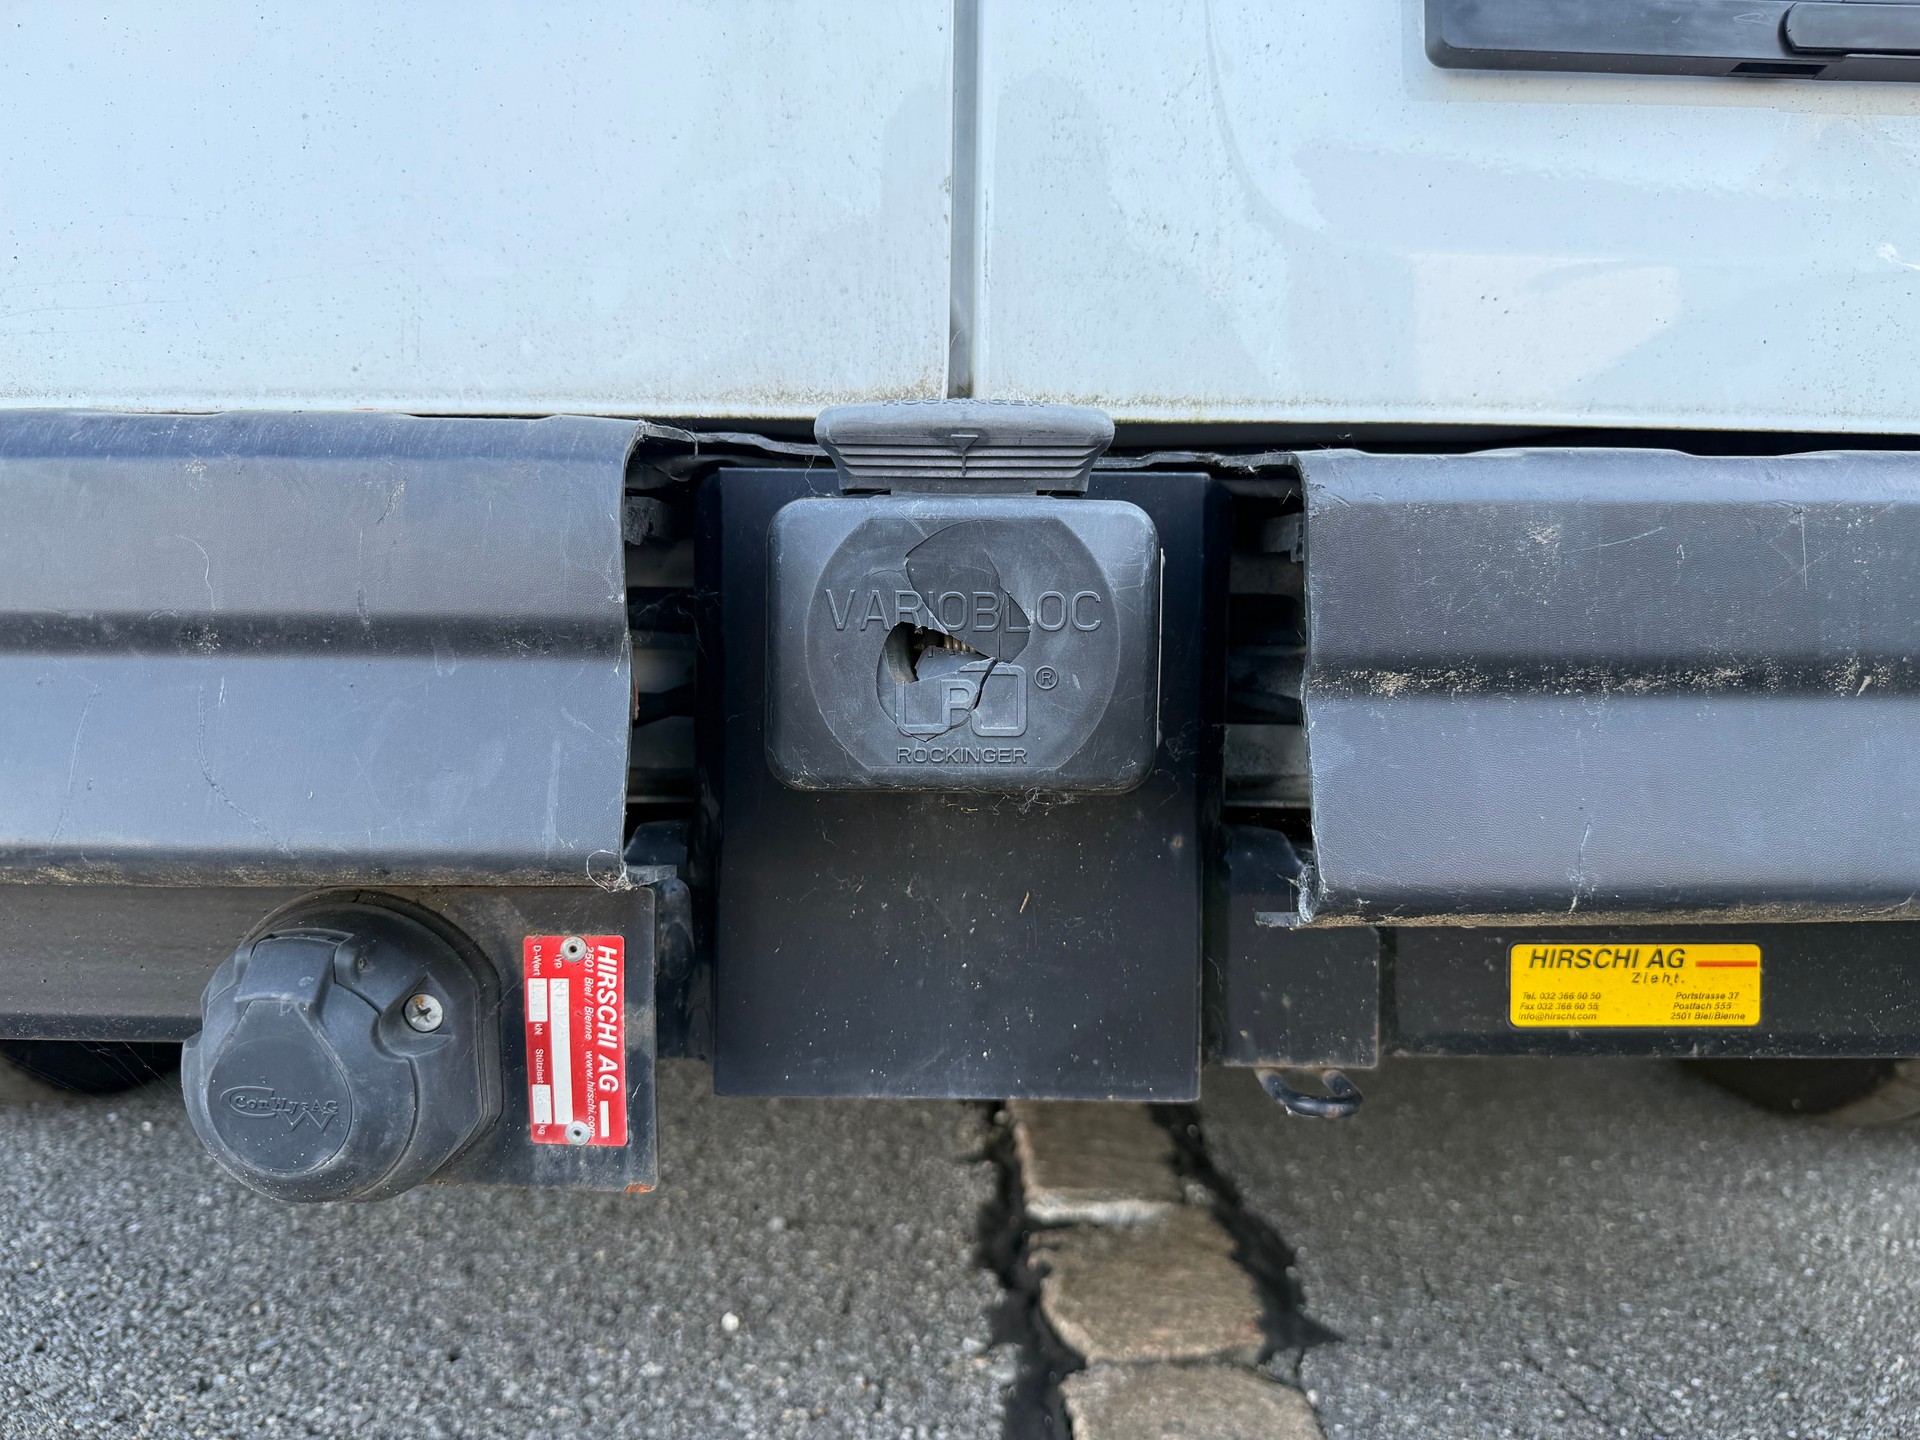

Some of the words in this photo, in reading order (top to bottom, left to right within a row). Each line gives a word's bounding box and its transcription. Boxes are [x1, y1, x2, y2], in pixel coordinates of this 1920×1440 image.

[825, 588, 1102, 634] VARIOBLOC
[896, 746, 1028, 764] ROCKINGER
[532, 945, 542, 976] D-Wert
[584, 947, 595, 973] 2501
[1528, 948, 1640, 969] HIRSCHI
[1646, 948, 1686, 969] AG
[584, 977, 594, 997] Biel
[1631, 972, 1686, 984] Zieht.
[597, 945, 618, 1049] HIRSCHI
[1522, 991, 1536, 1000] Tel.
[1539, 992, 1556, 1000] 032
[1675, 991, 1726, 1000] Portstrasse
[1728, 991, 1740, 1000] 37
[1519, 1002, 1535, 1010] Fax
[1536, 1002, 1554, 1010] 032
[1670, 1012, 1691, 1020] 2501
[1672, 1002, 1712, 1010] Postfach
[584, 1006, 594, 1040] Bienne
[1518, 1012, 1597, 1021] info@hirschi.com
[598, 1053, 619, 1093] AG
[585, 1050, 597, 1137] www.hirschi.com
